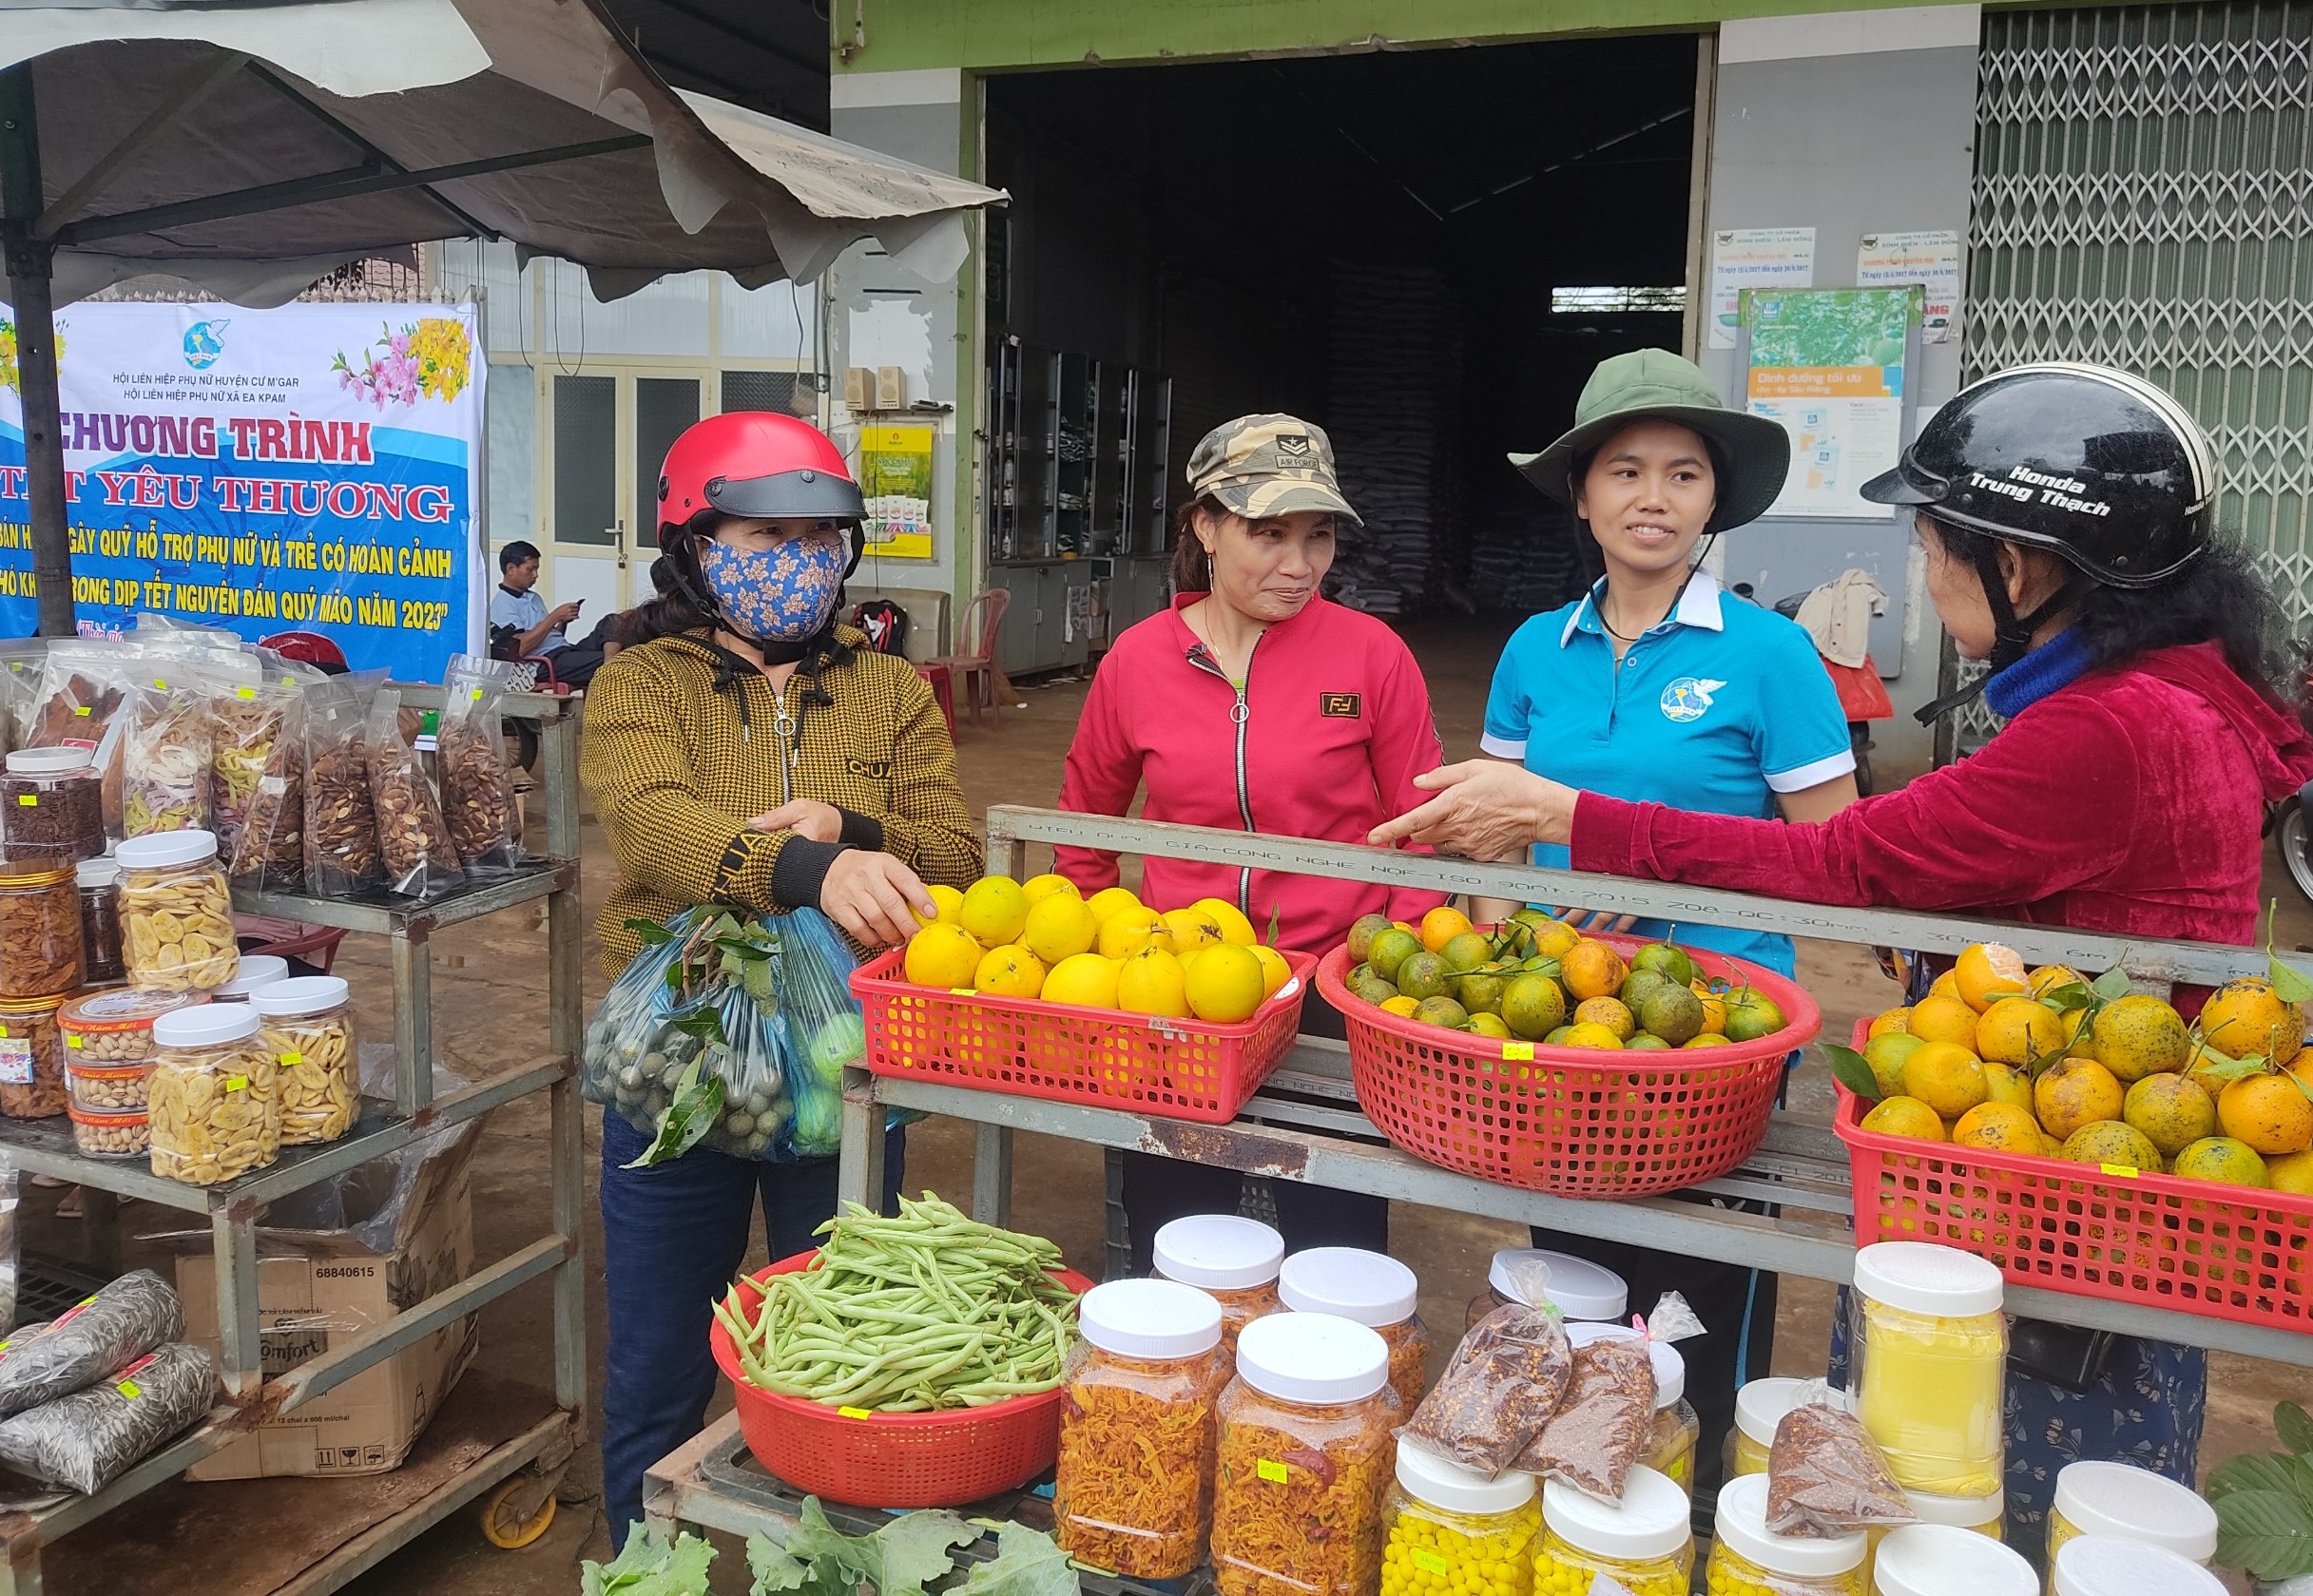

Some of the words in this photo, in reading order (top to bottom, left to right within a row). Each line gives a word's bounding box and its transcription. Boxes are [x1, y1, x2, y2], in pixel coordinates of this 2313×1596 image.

[113, 372, 129, 384] HỘI
[132, 373, 152, 385] LIÊN
[154, 373, 176, 386] HIỆP
[178, 375, 196, 387] PHỤ
[200, 375, 214, 386] NỮ
[216, 375, 248, 387] HUYỆN
[251, 375, 265, 387] CƯ
[267, 376, 299, 388] M'GAR
[1758, 373, 1784, 383] Dinh
[124, 388, 140, 400] HỘI
[143, 389, 164, 400] LIÊN
[165, 389, 186, 402] HIỆP
[189, 392, 206, 403] PHỤ
[211, 390, 225, 402] NỮ
[226, 390, 240, 402] XÃ
[243, 393, 255, 402] EA
[259, 393, 286, 403] KPAM
[229, 411, 372, 462] TRÌNH
[1280, 457, 1294, 466] AIR
[1294, 458, 1319, 469] FORCE
[2009, 466, 2086, 494] Honda
[0, 466, 86, 504] TT
[98, 465, 202, 509] YÊU
[215, 475, 453, 522] THƯƠNG
[1970, 472, 2034, 502] Trung
[2039, 490, 2111, 516] Thạch
[68, 520, 96, 555] GÂY
[100, 524, 132, 558] QUỸ
[136, 519, 158, 560] HỖ
[163, 531, 193, 567] TRỢ
[198, 535, 228, 569] PHỤ
[233, 532, 258, 567] NỮ
[260, 532, 280, 567] VÀ
[285, 531, 318, 570] TRẺ
[321, 536, 346, 571] CÓ
[348, 538, 394, 575] HOÀN
[398, 537, 452, 578] CẢNH
[0, 563, 17, 596] HÓ
[71, 575, 111, 606] RONG
[114, 579, 140, 612] DỊP
[144, 569, 172, 609] TẾT
[176, 581, 240, 616] NGUYÊN
[243, 583, 277, 618] ĐÁN
[280, 586, 318, 623] QUÝ
[318, 588, 353, 625] MÃO
[357, 590, 396, 628] NĂM
[1296, 856, 1357, 870] NGHE
[316, 1266, 375, 1279] 68840615
[260, 1339, 320, 1362] omfort
